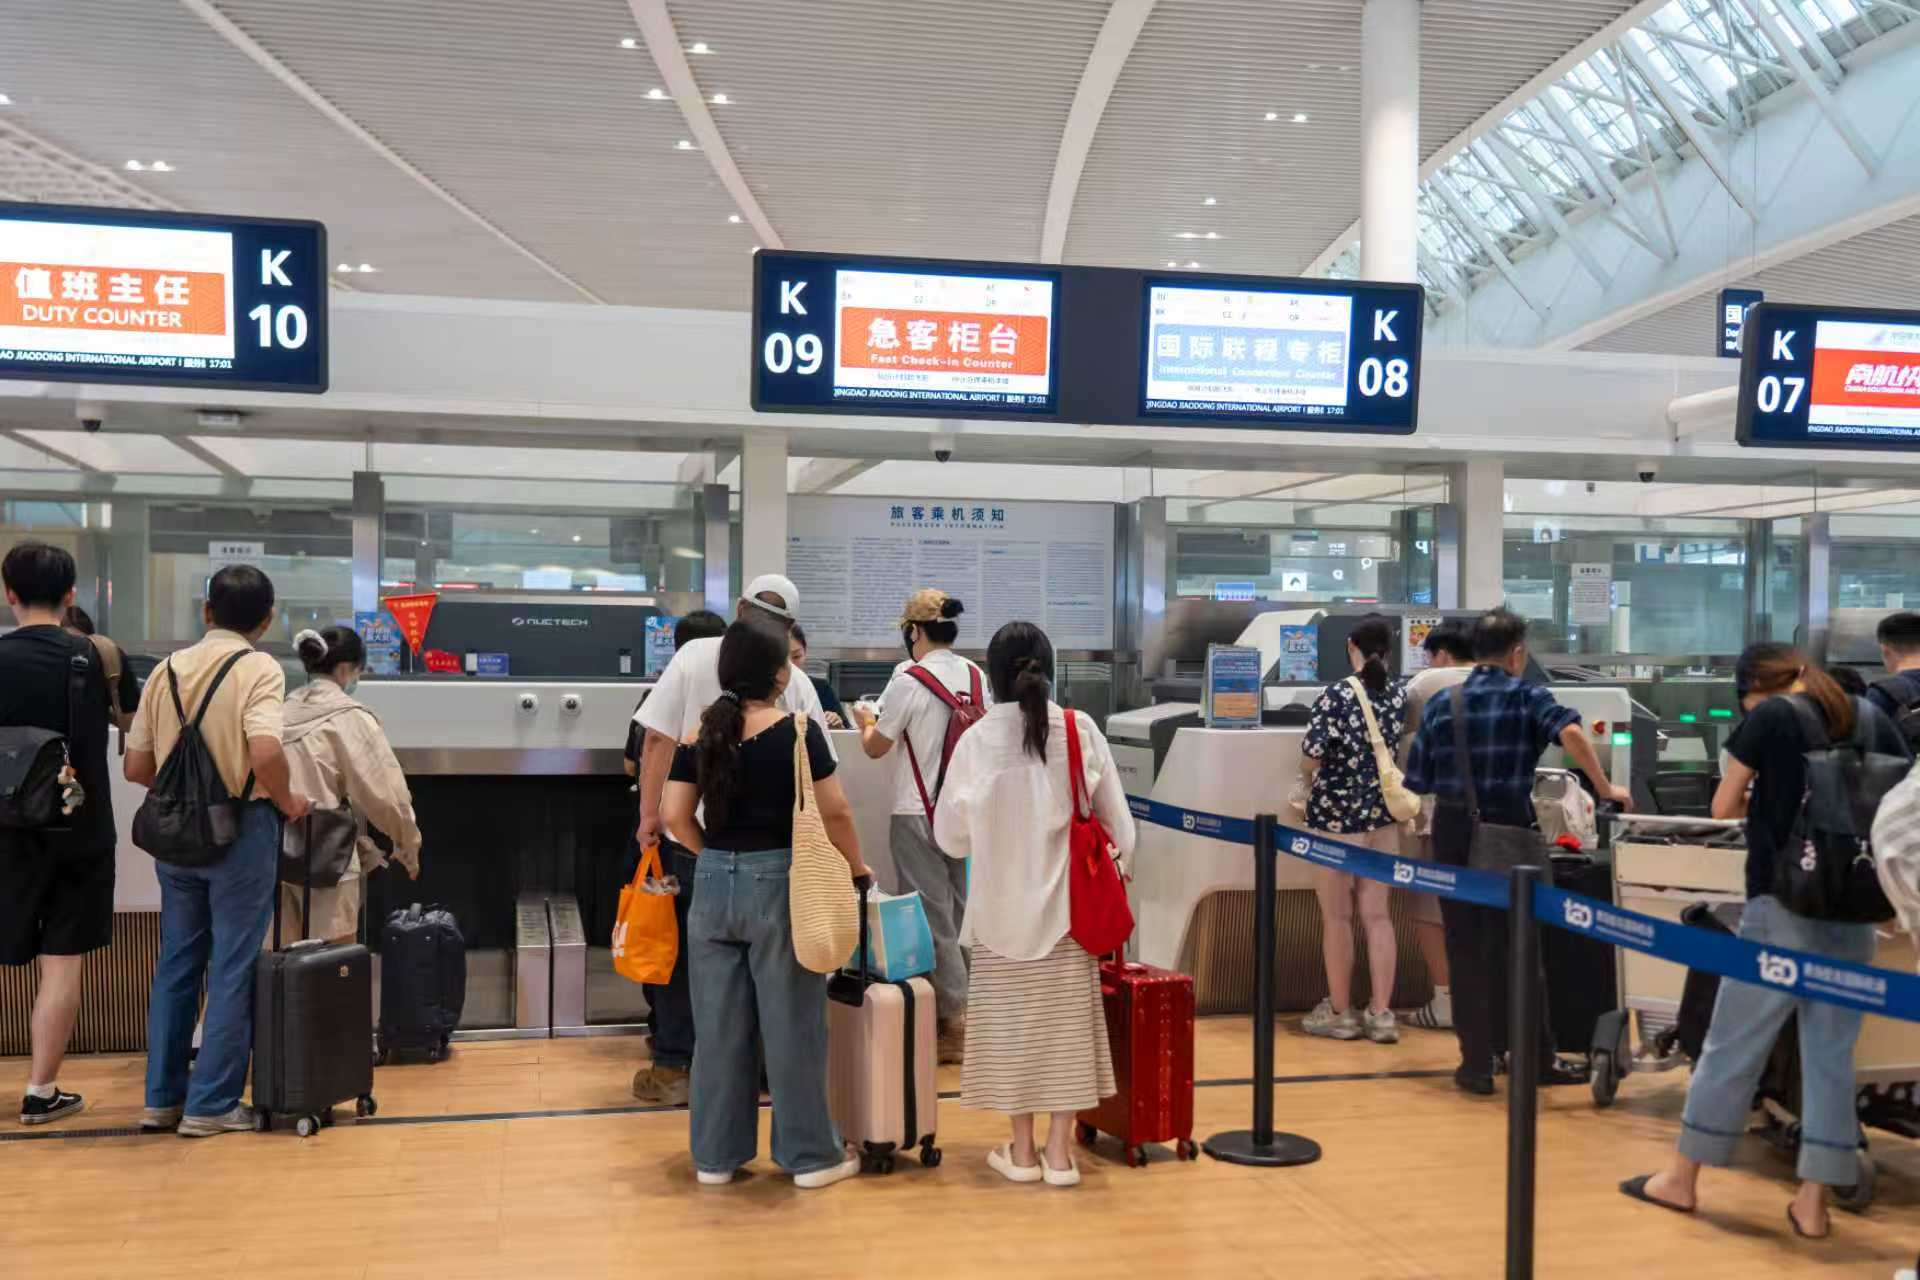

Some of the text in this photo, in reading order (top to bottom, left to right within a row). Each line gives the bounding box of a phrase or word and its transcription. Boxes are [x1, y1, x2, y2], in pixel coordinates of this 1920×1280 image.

[261, 248, 293, 287] K
[14, 266, 191, 306] 值班主任
[780, 280, 808, 315] K
[22, 303, 183, 328] DUTY COUNTER
[248, 304, 308, 349] 10
[1373, 309, 1398, 342] K
[764, 331, 823, 375] 09
[866, 316, 1019, 356] 急客柜台
[1772, 330, 1796, 361] K
[15, 351, 64, 362] JIAODONG
[65, 352, 137, 365] INTERNATIONAL
[137, 355, 176, 367] AIRPORT
[870, 353, 1014, 369] Fast Check-in Counter
[1358, 356, 1409, 398] 08
[868, 389, 910, 399] JIAODONG
[910, 391, 969, 402] INTERNATIONAL
[969, 393, 1001, 402] AIRPORT
[1216, 403, 1271, 413] INTERNATIONAL
[1272, 405, 1302, 414] AIRPORT
[1757, 376, 1805, 413] 07
[890, 505, 1005, 522] 旅客乘机须知
